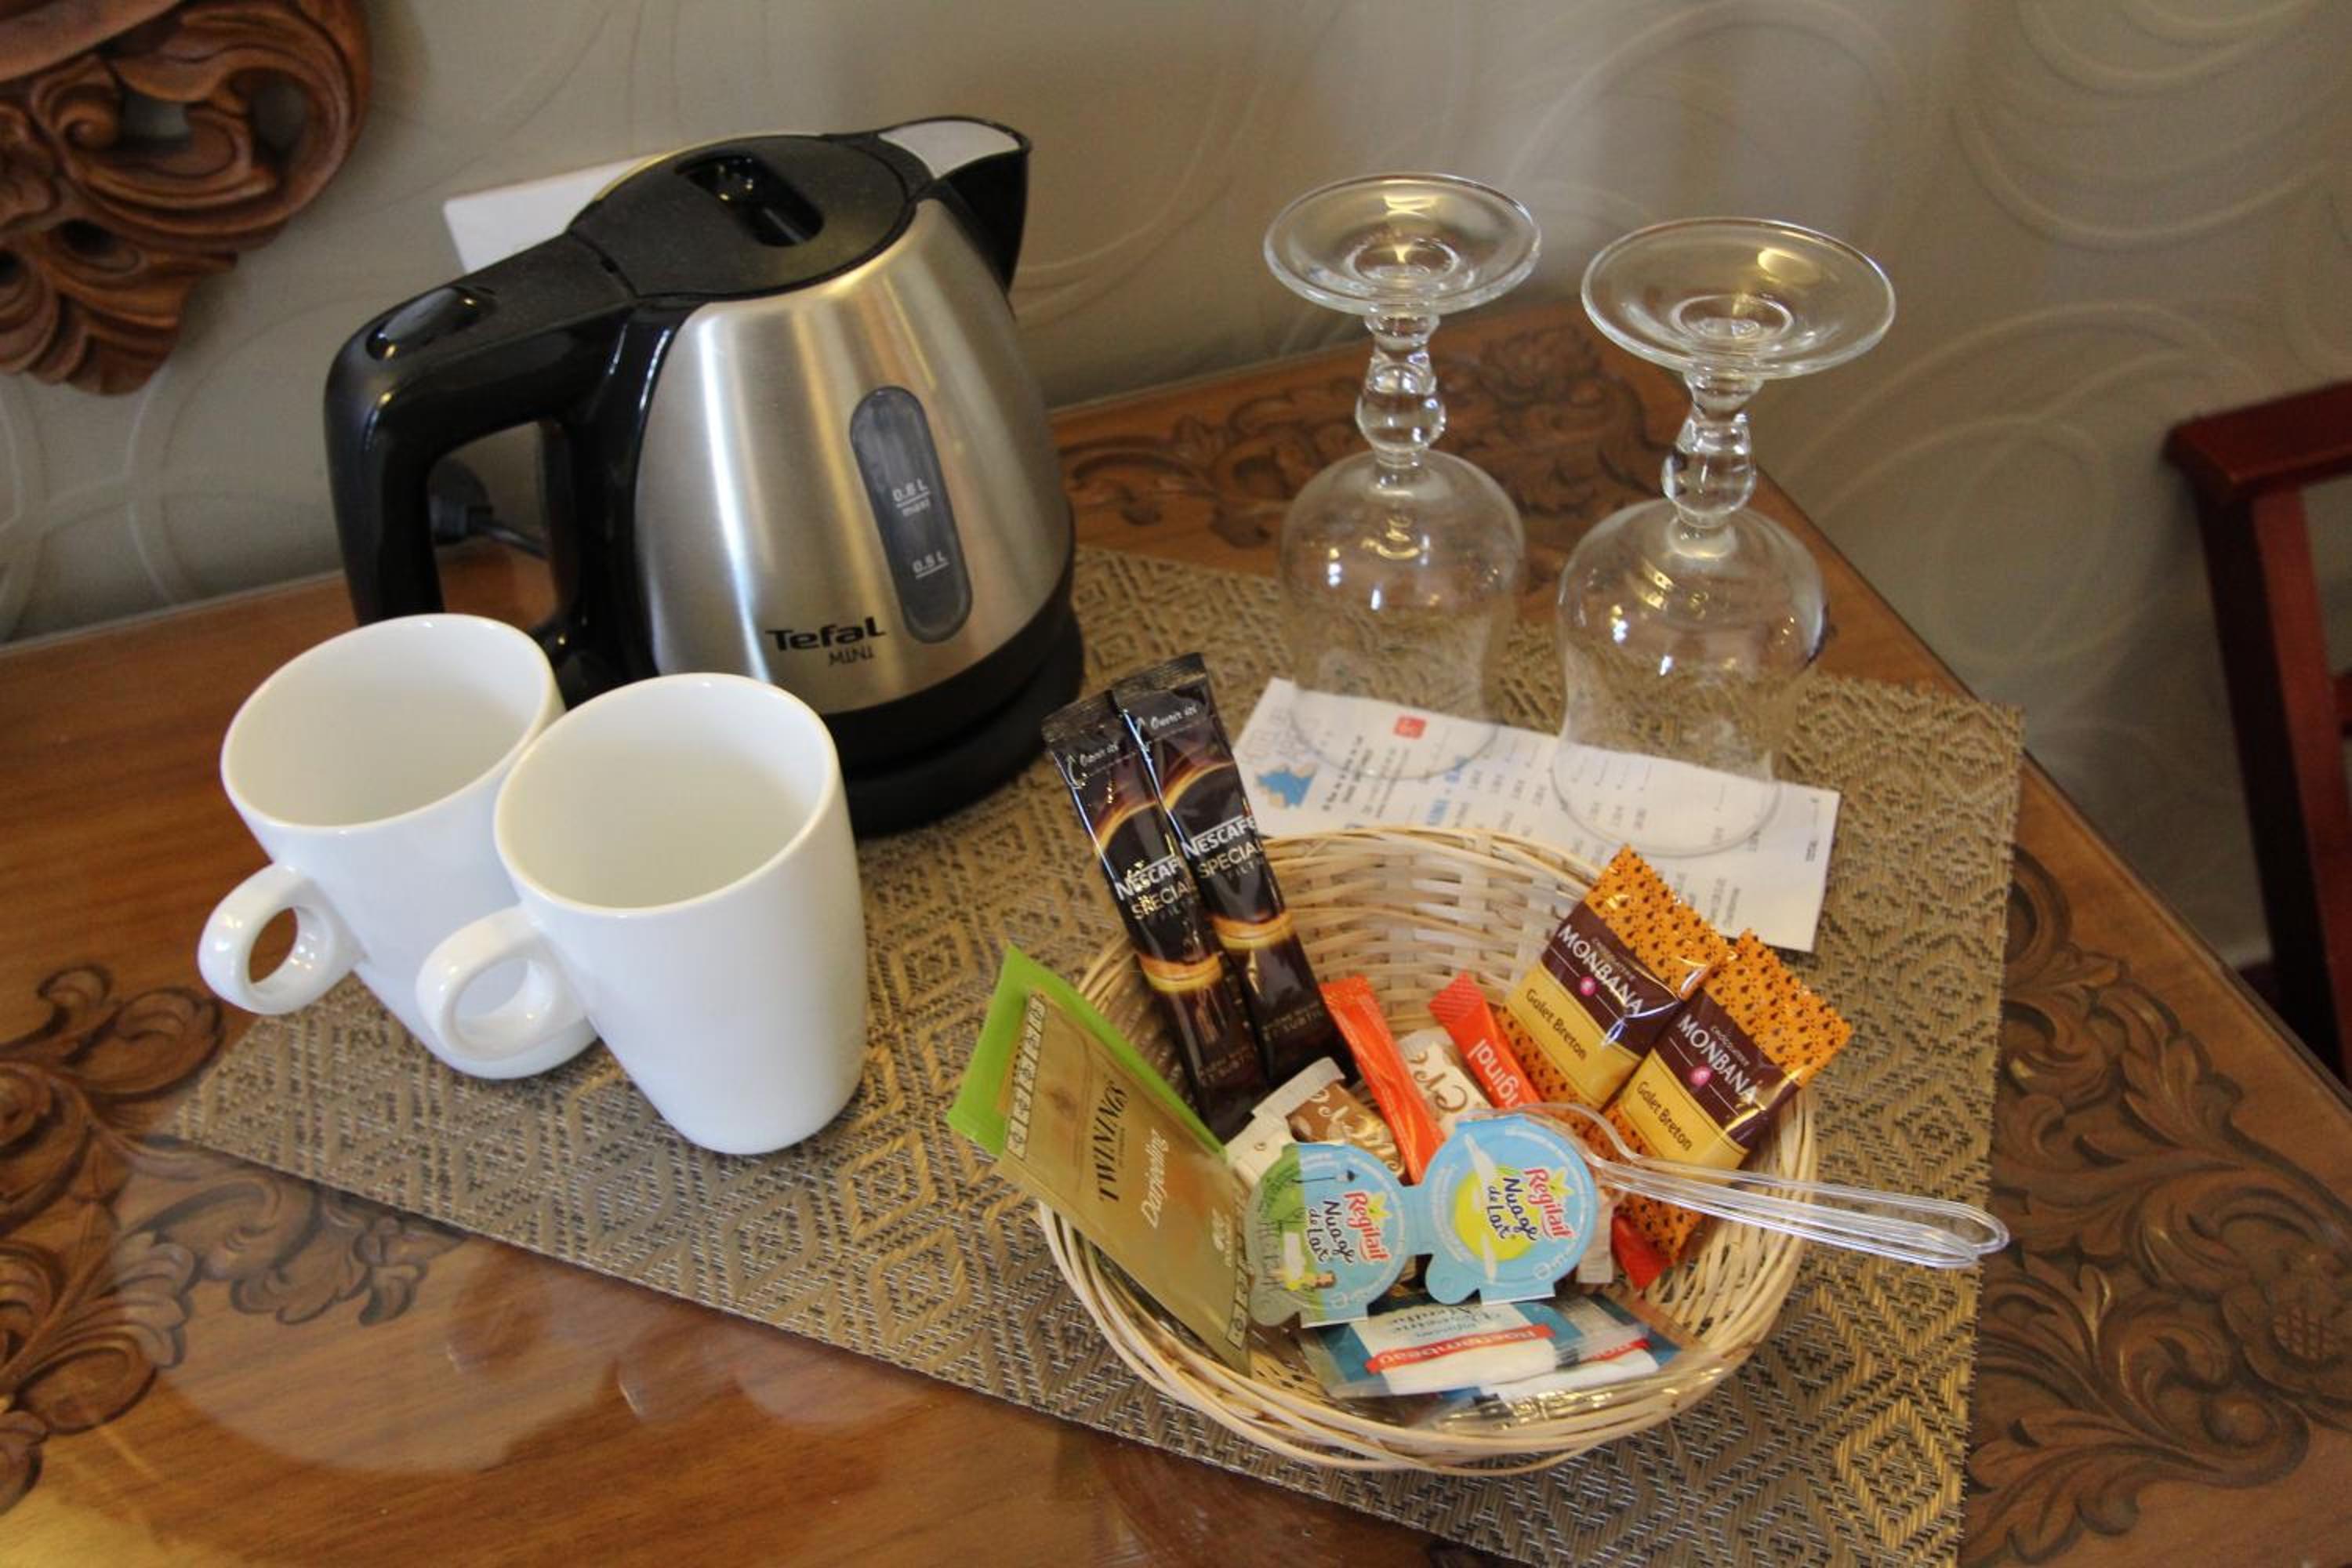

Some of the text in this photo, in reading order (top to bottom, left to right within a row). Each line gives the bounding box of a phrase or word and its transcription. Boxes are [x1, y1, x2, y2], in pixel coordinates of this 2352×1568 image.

[765, 616, 887, 652] Tefal
[829, 647, 874, 666] MINI
[1115, 852, 1182, 902] NESCAF
[1557, 924, 1646, 1018] MONBANA
[1525, 988, 1588, 1062] Galet Breton
[1678, 1014, 1760, 1107] MONBANA
[1467, 1037, 1526, 1111] riginal
[1092, 1080, 1128, 1203] TWININGS
[1635, 1080, 1694, 1152] Galet Breton
[1141, 1127, 1171, 1229] Darjeeling
[1502, 1177, 1538, 1241] Nuage
[1323, 1200, 1354, 1266] Nuage
